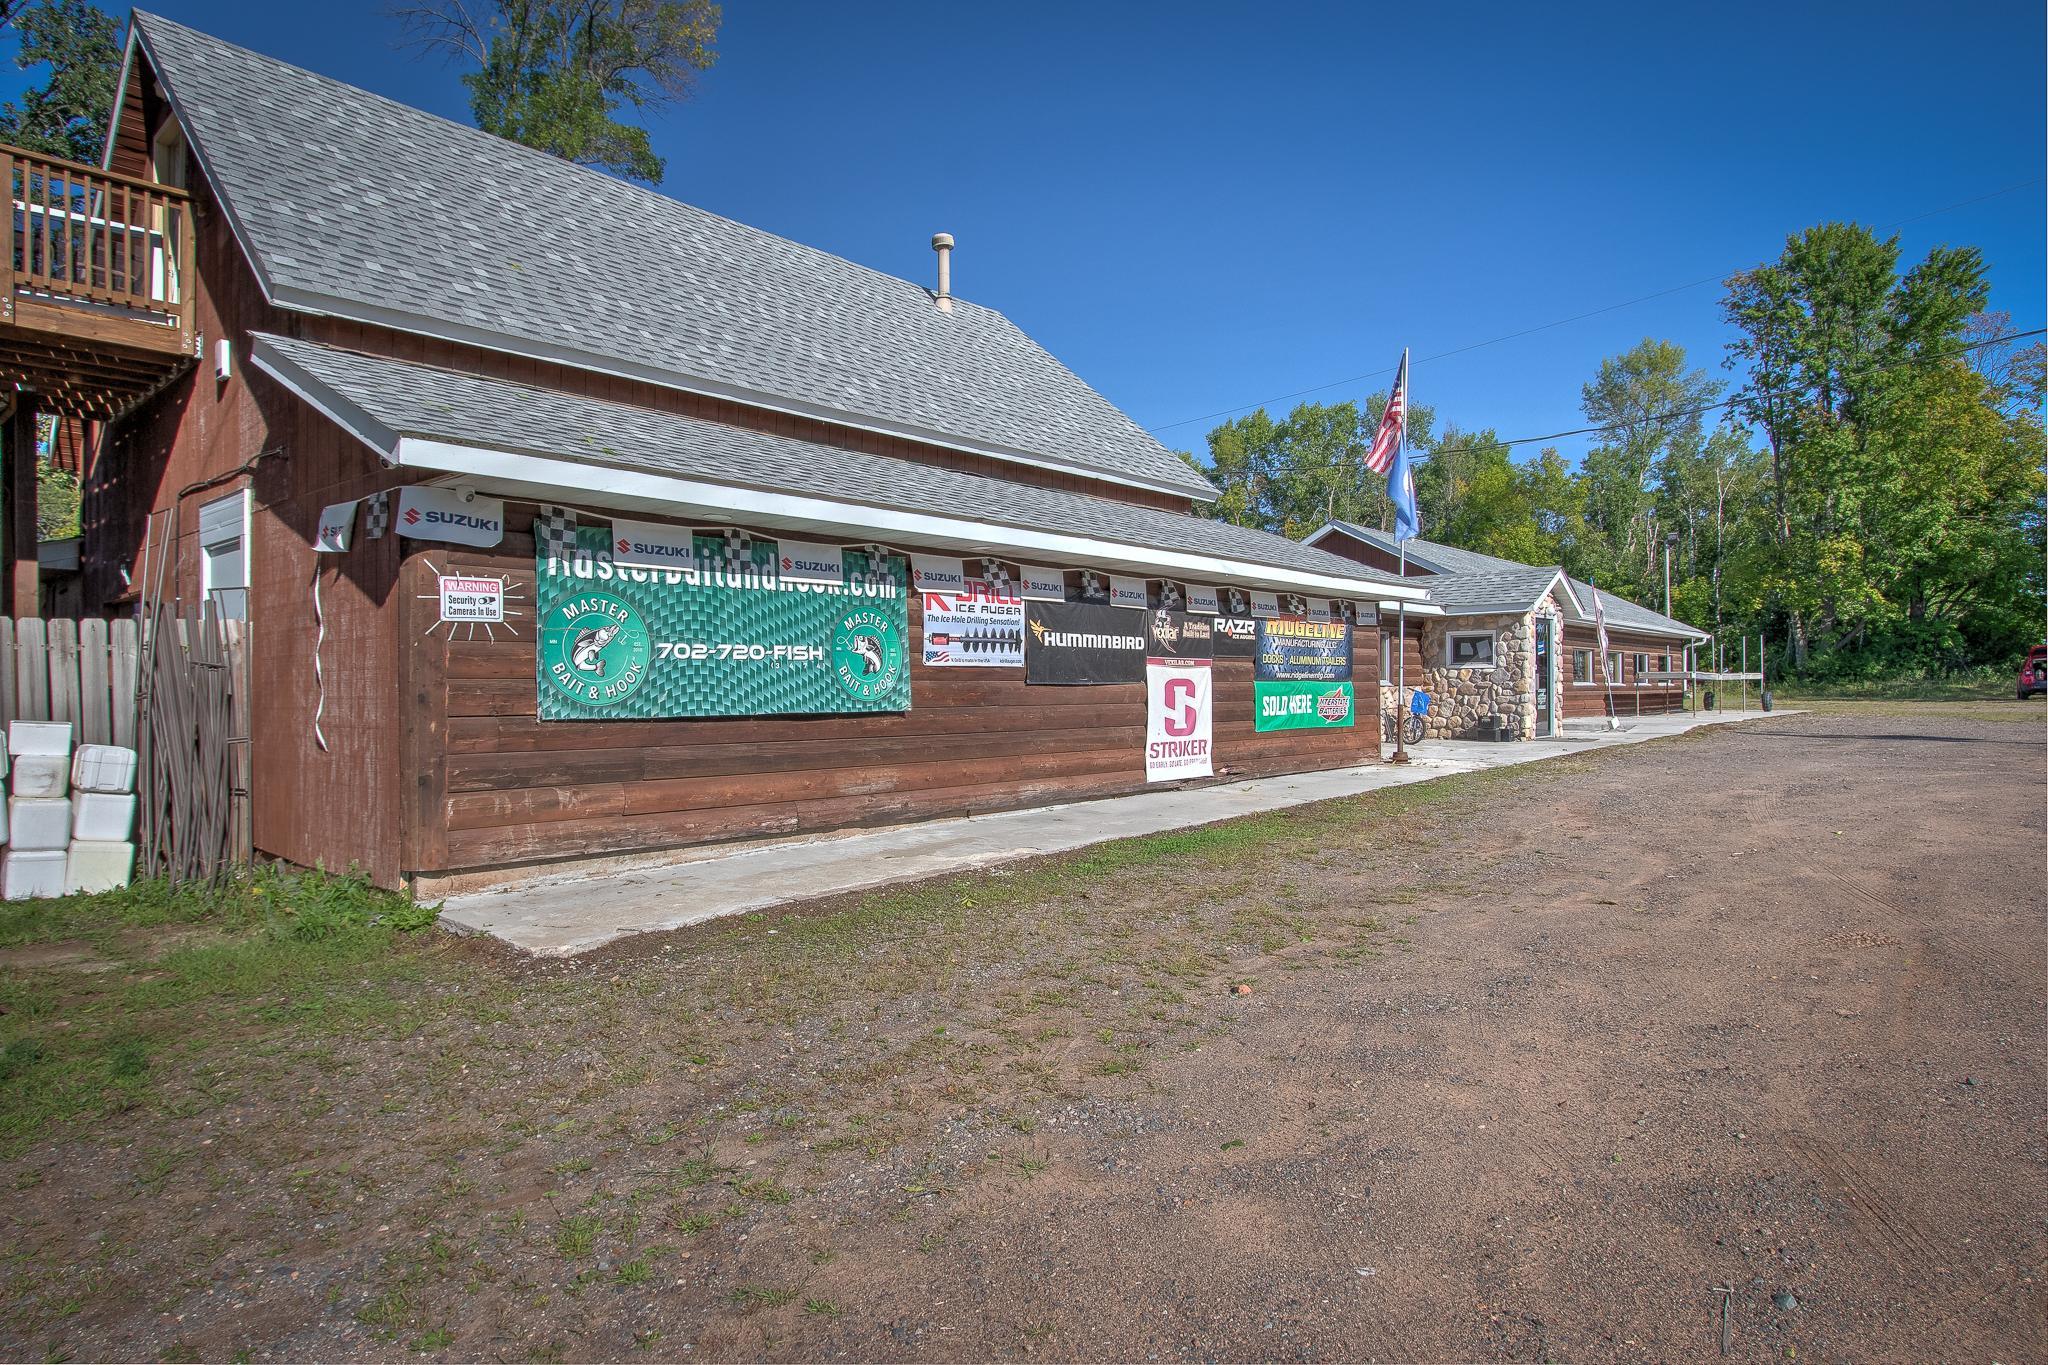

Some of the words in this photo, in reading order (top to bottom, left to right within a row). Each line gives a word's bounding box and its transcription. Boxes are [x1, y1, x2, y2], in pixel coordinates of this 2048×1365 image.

[424, 511, 499, 532] SUZUKI
[634, 542, 690, 558] SUZUKI
[794, 560, 841, 573] SUZUKI
[923, 572, 961, 583] SUZUKI
[448, 580, 498, 592] WARNING
[1031, 581, 1062, 592] SUZUKI
[448, 594, 477, 606] Security
[1119, 590, 1145, 600] SUZUKI
[955, 604, 976, 613] ICE
[980, 605, 1021, 615] AUGER
[1193, 598, 1217, 607] SUZUKI
[448, 606, 477, 616] Cameras
[478, 606, 485, 616] In
[485, 607, 497, 616] Use
[562, 598, 629, 624] MASTER
[843, 612, 888, 633] MASTER
[927, 614, 940, 623] The
[941, 615, 951, 623] Ice
[951, 616, 965, 624] Hole
[966, 616, 989, 626] Drilling
[989, 617, 1020, 626] Sensation!
[1214, 618, 1255, 634] RAZR
[1044, 631, 1145, 650] HUMMINBIRD
[655, 642, 824, 661] 702-720-FISH
[552, 662, 585, 695] BAIT
[588, 685, 599, 700] &
[605, 660, 643, 698] HOOK
[839, 665, 861, 692] BAIT
[862, 684, 871, 696] &
[873, 664, 897, 694] HOOK
[1262, 695, 1288, 716] SOLD
[1289, 694, 1313, 714] HERE
[1318, 706, 1347, 715] BATTERIES
[1149, 739, 1208, 759] STRIKER
